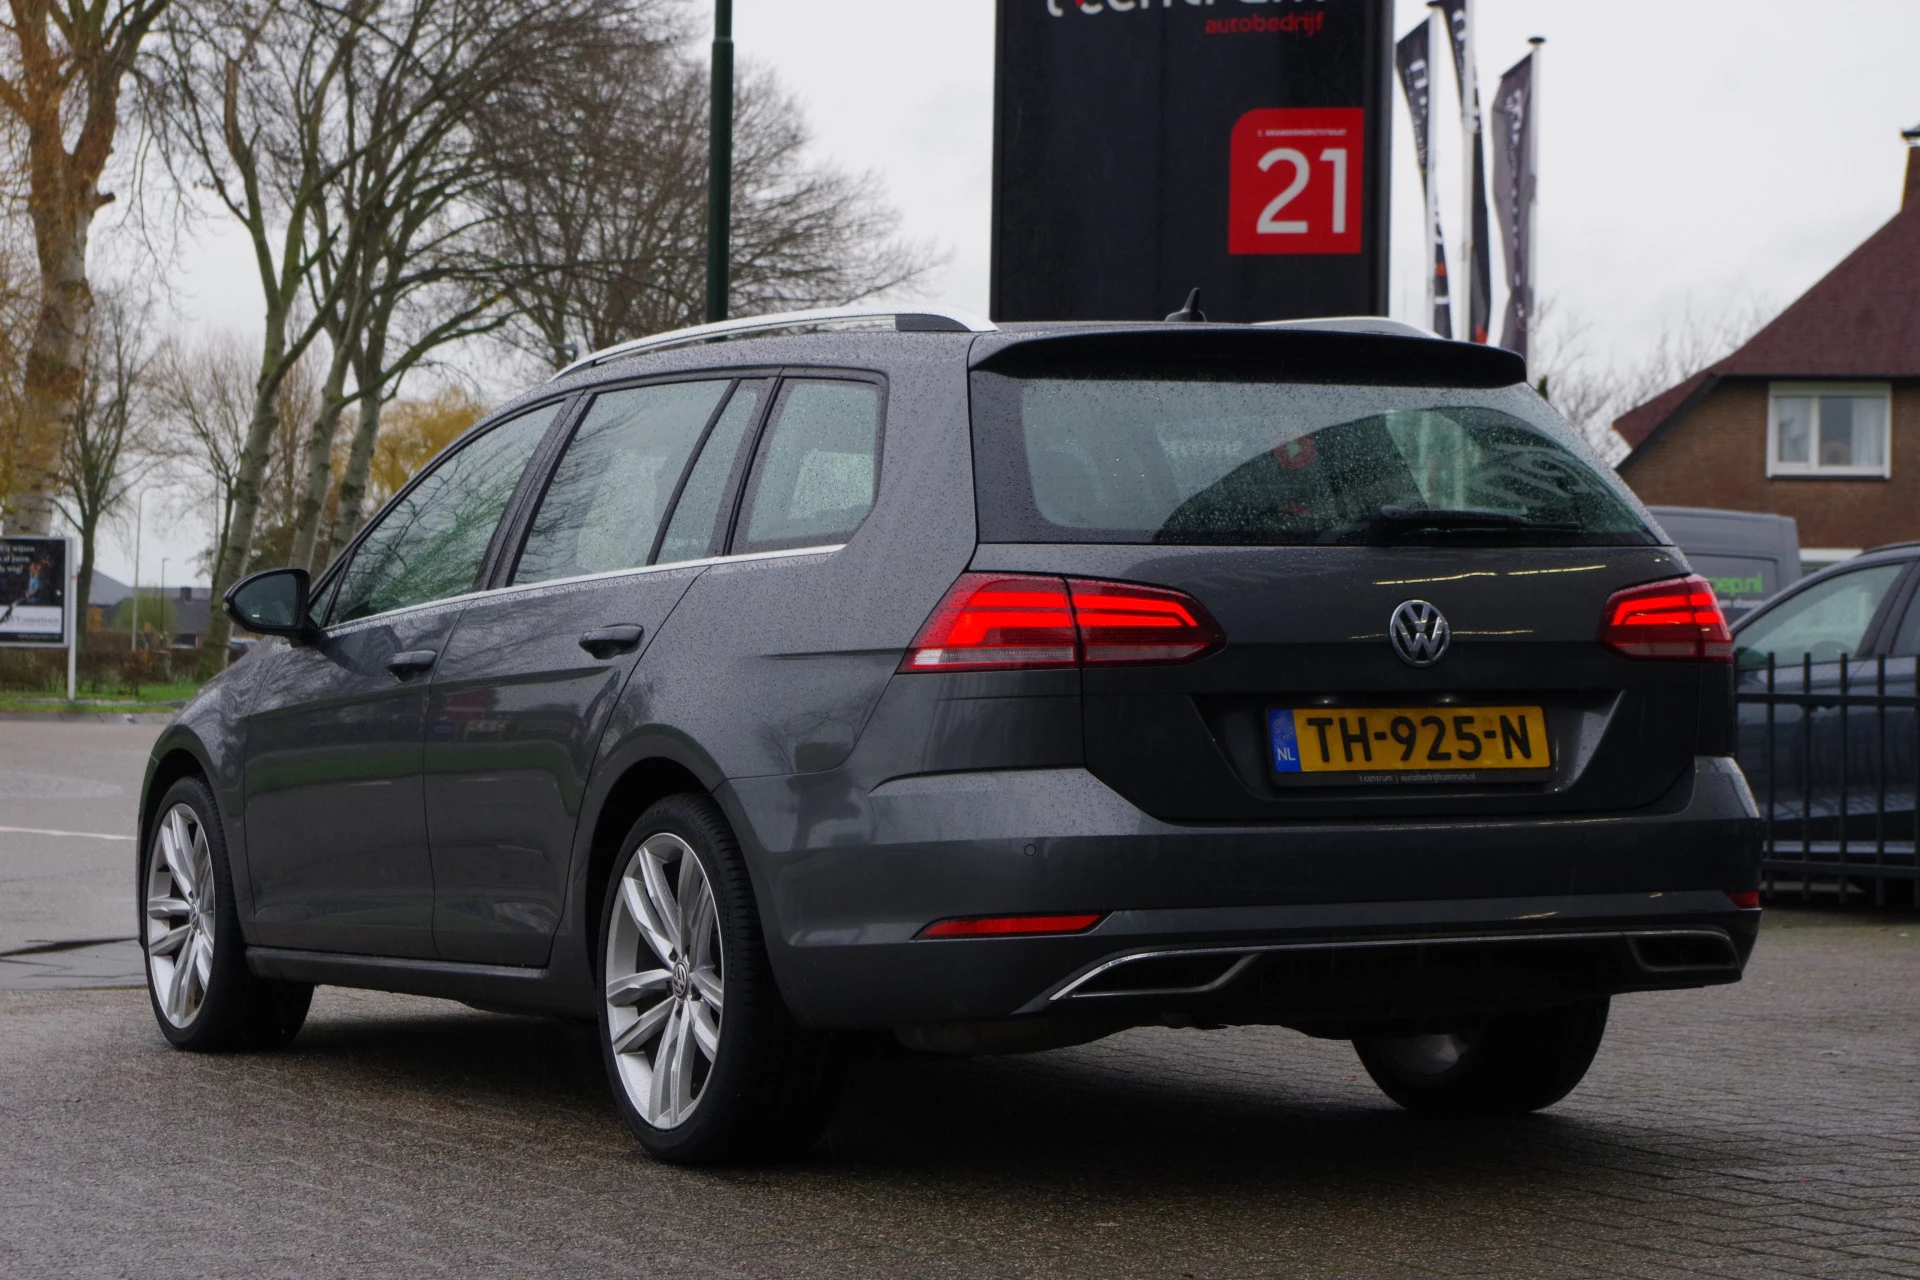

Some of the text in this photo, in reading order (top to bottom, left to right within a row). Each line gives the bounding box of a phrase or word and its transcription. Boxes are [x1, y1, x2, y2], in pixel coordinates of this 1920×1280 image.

[1205, 12, 1325, 36] autobedrijf
[1256, 148, 1347, 234] 21
[1277, 747, 1296, 761] NL
[1307, 715, 1531, 762] TH-925-N
